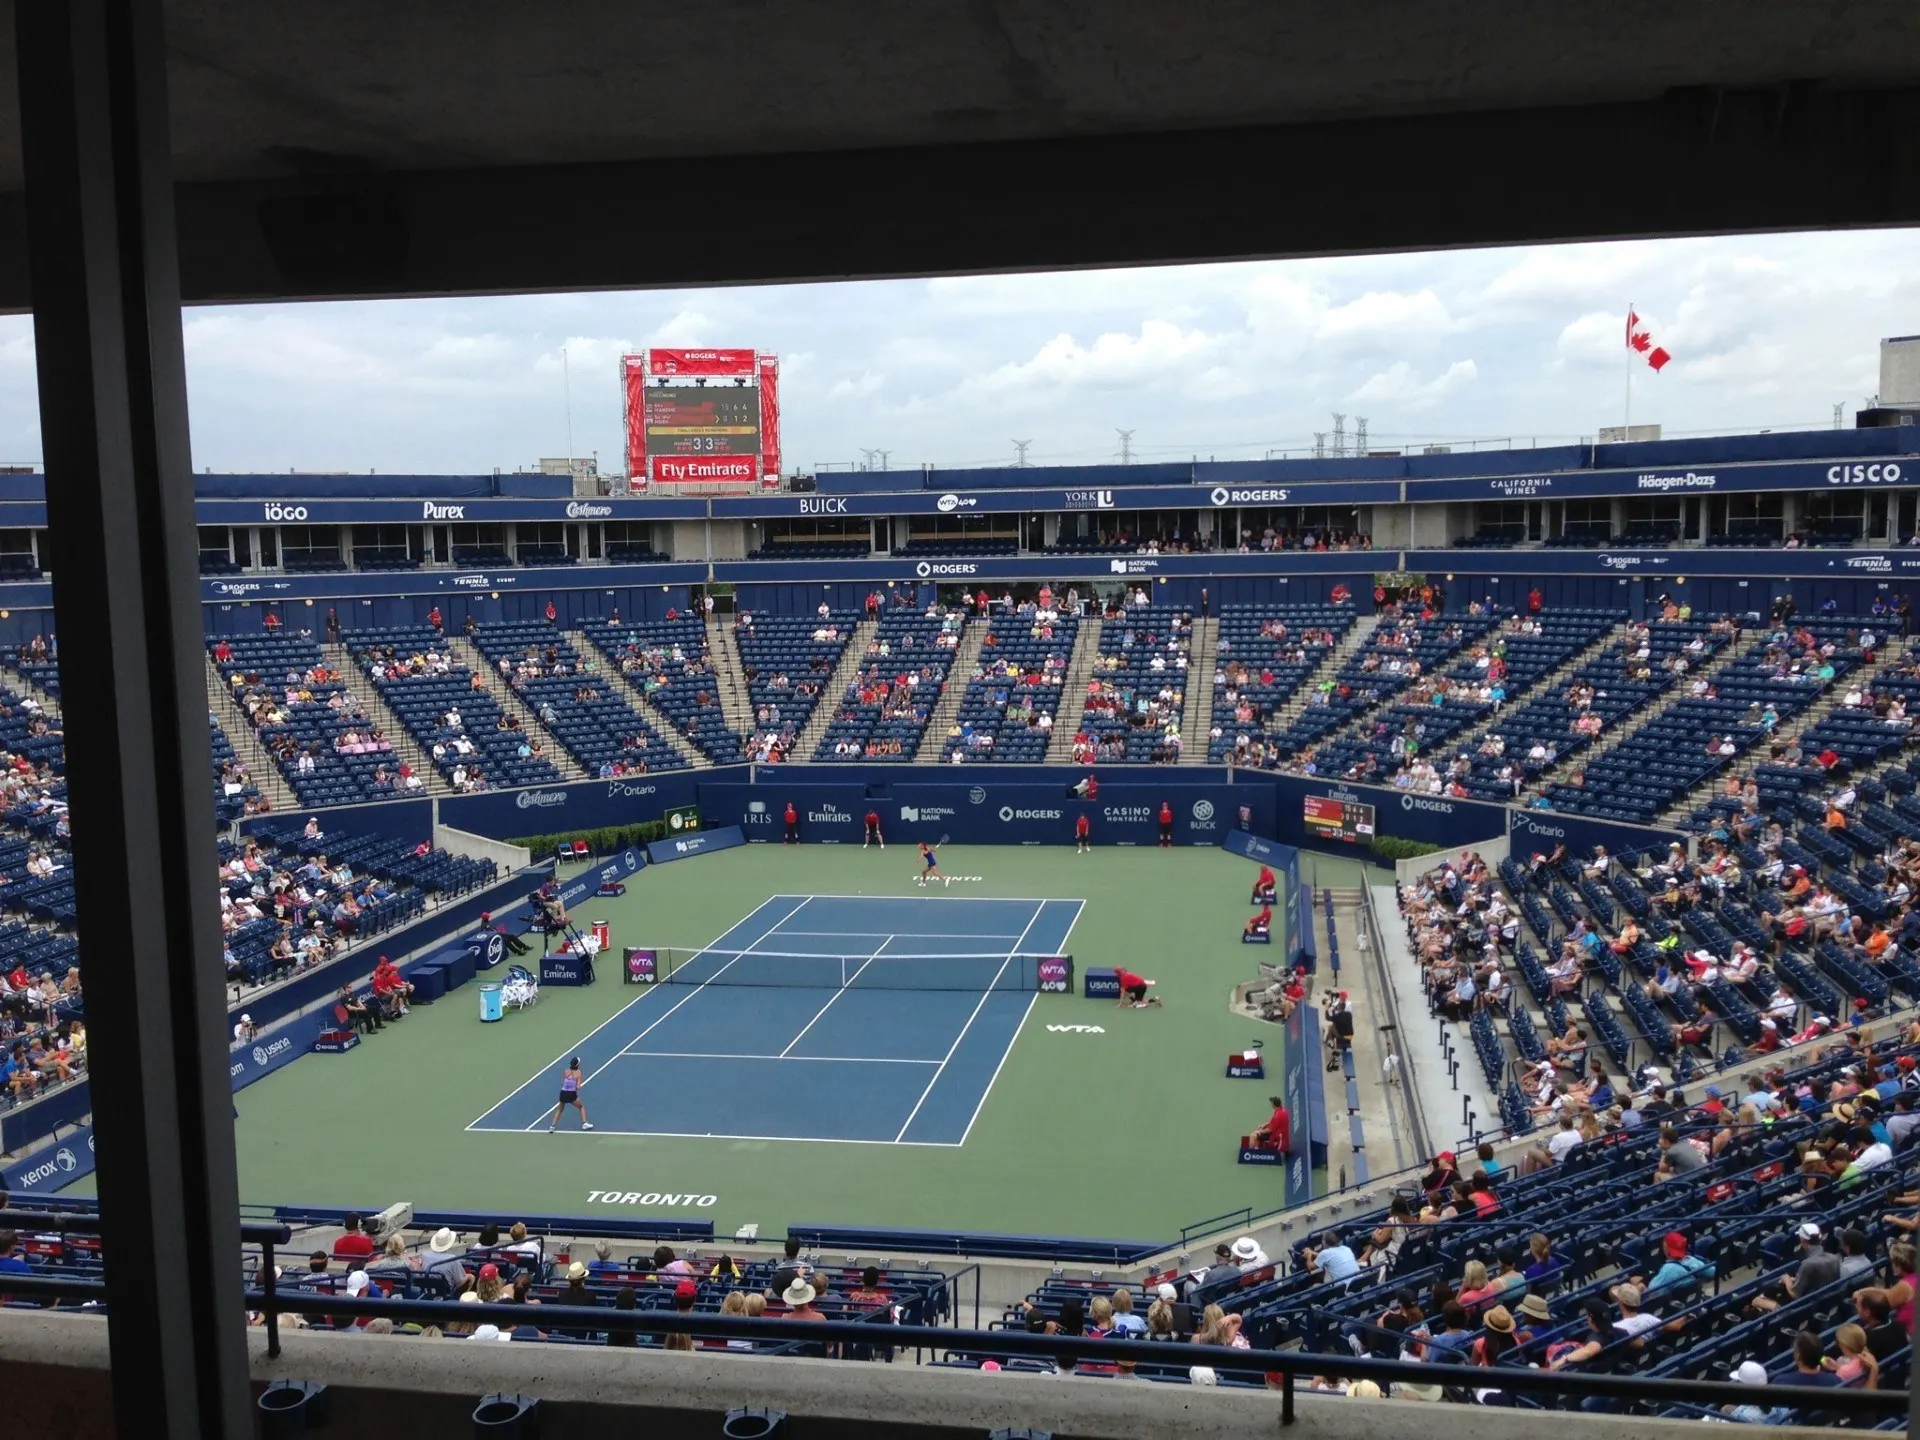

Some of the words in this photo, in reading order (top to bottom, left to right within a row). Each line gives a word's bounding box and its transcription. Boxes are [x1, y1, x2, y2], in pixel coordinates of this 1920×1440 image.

[693, 438, 701, 450] 3
[705, 438, 714, 450] 3
[661, 464, 685, 479] Fly
[688, 463, 750, 477] Emirates
[1826, 464, 1901, 484] CISCO
[1490, 478, 1552, 489] CALIFORNIA
[1065, 491, 1097, 501] YORK
[1231, 489, 1288, 502] ROGERS
[1504, 487, 1536, 495] WINES
[423, 501, 466, 519] Purex
[800, 498, 847, 513] BUICK
[1847, 559, 1892, 567] TENNIS
[932, 564, 977, 574] ROGERS
[453, 577, 489, 585] TENNIS
[624, 786, 656, 796] Ontario
[822, 803, 836, 813] Fly
[1415, 799, 1454, 813] ROGERS
[1016, 809, 1061, 819] ROGERS
[1104, 806, 1150, 817] CASINO
[744, 813, 772, 824] IRIS
[808, 811, 851, 823] Emirates
[1106, 814, 1148, 822] MONTRÉAL
[1190, 821, 1216, 830] BUICK
[1528, 822, 1565, 838] Ontario
[631, 958, 653, 967] WTA
[544, 970, 577, 979] Emirates
[1041, 966, 1066, 975] WTA
[632, 973, 645, 982] 40
[1041, 981, 1056, 991] 40
[1089, 981, 1119, 990] USANA
[1046, 1024, 1105, 1033] WTA
[265, 1037, 291, 1056] USANA
[20, 1160, 58, 1188] xerox
[586, 1190, 718, 1207] TORONTO
